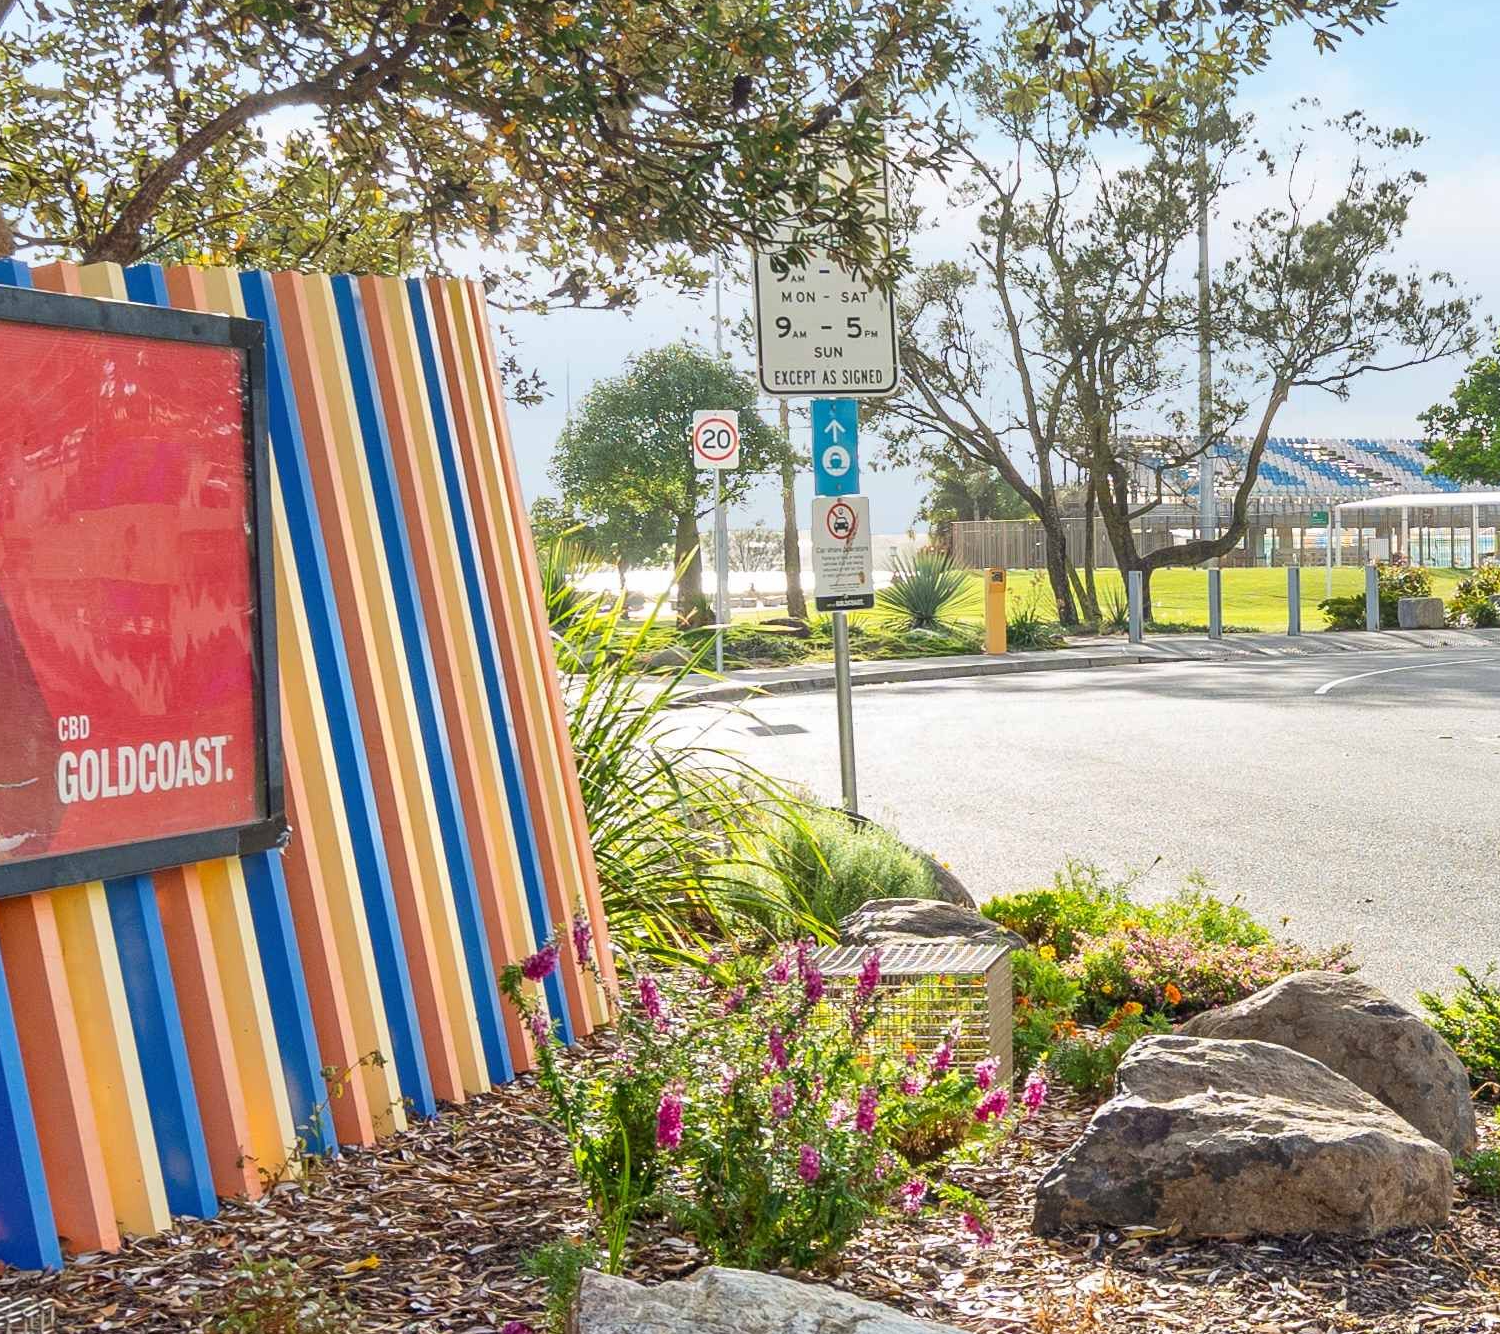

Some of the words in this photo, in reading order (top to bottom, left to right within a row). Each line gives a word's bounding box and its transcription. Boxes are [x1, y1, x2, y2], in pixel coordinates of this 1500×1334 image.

[781, 291, 816, 303] MON
[840, 291, 868, 303] SAT
[814, 346, 843, 358] SUN
[775, 370, 816, 386] EXCEPT
[822, 370, 837, 385] AS
[842, 369, 883, 385] SIGNED
[702, 429, 731, 449] 20
[58, 715, 90, 742] CBD
